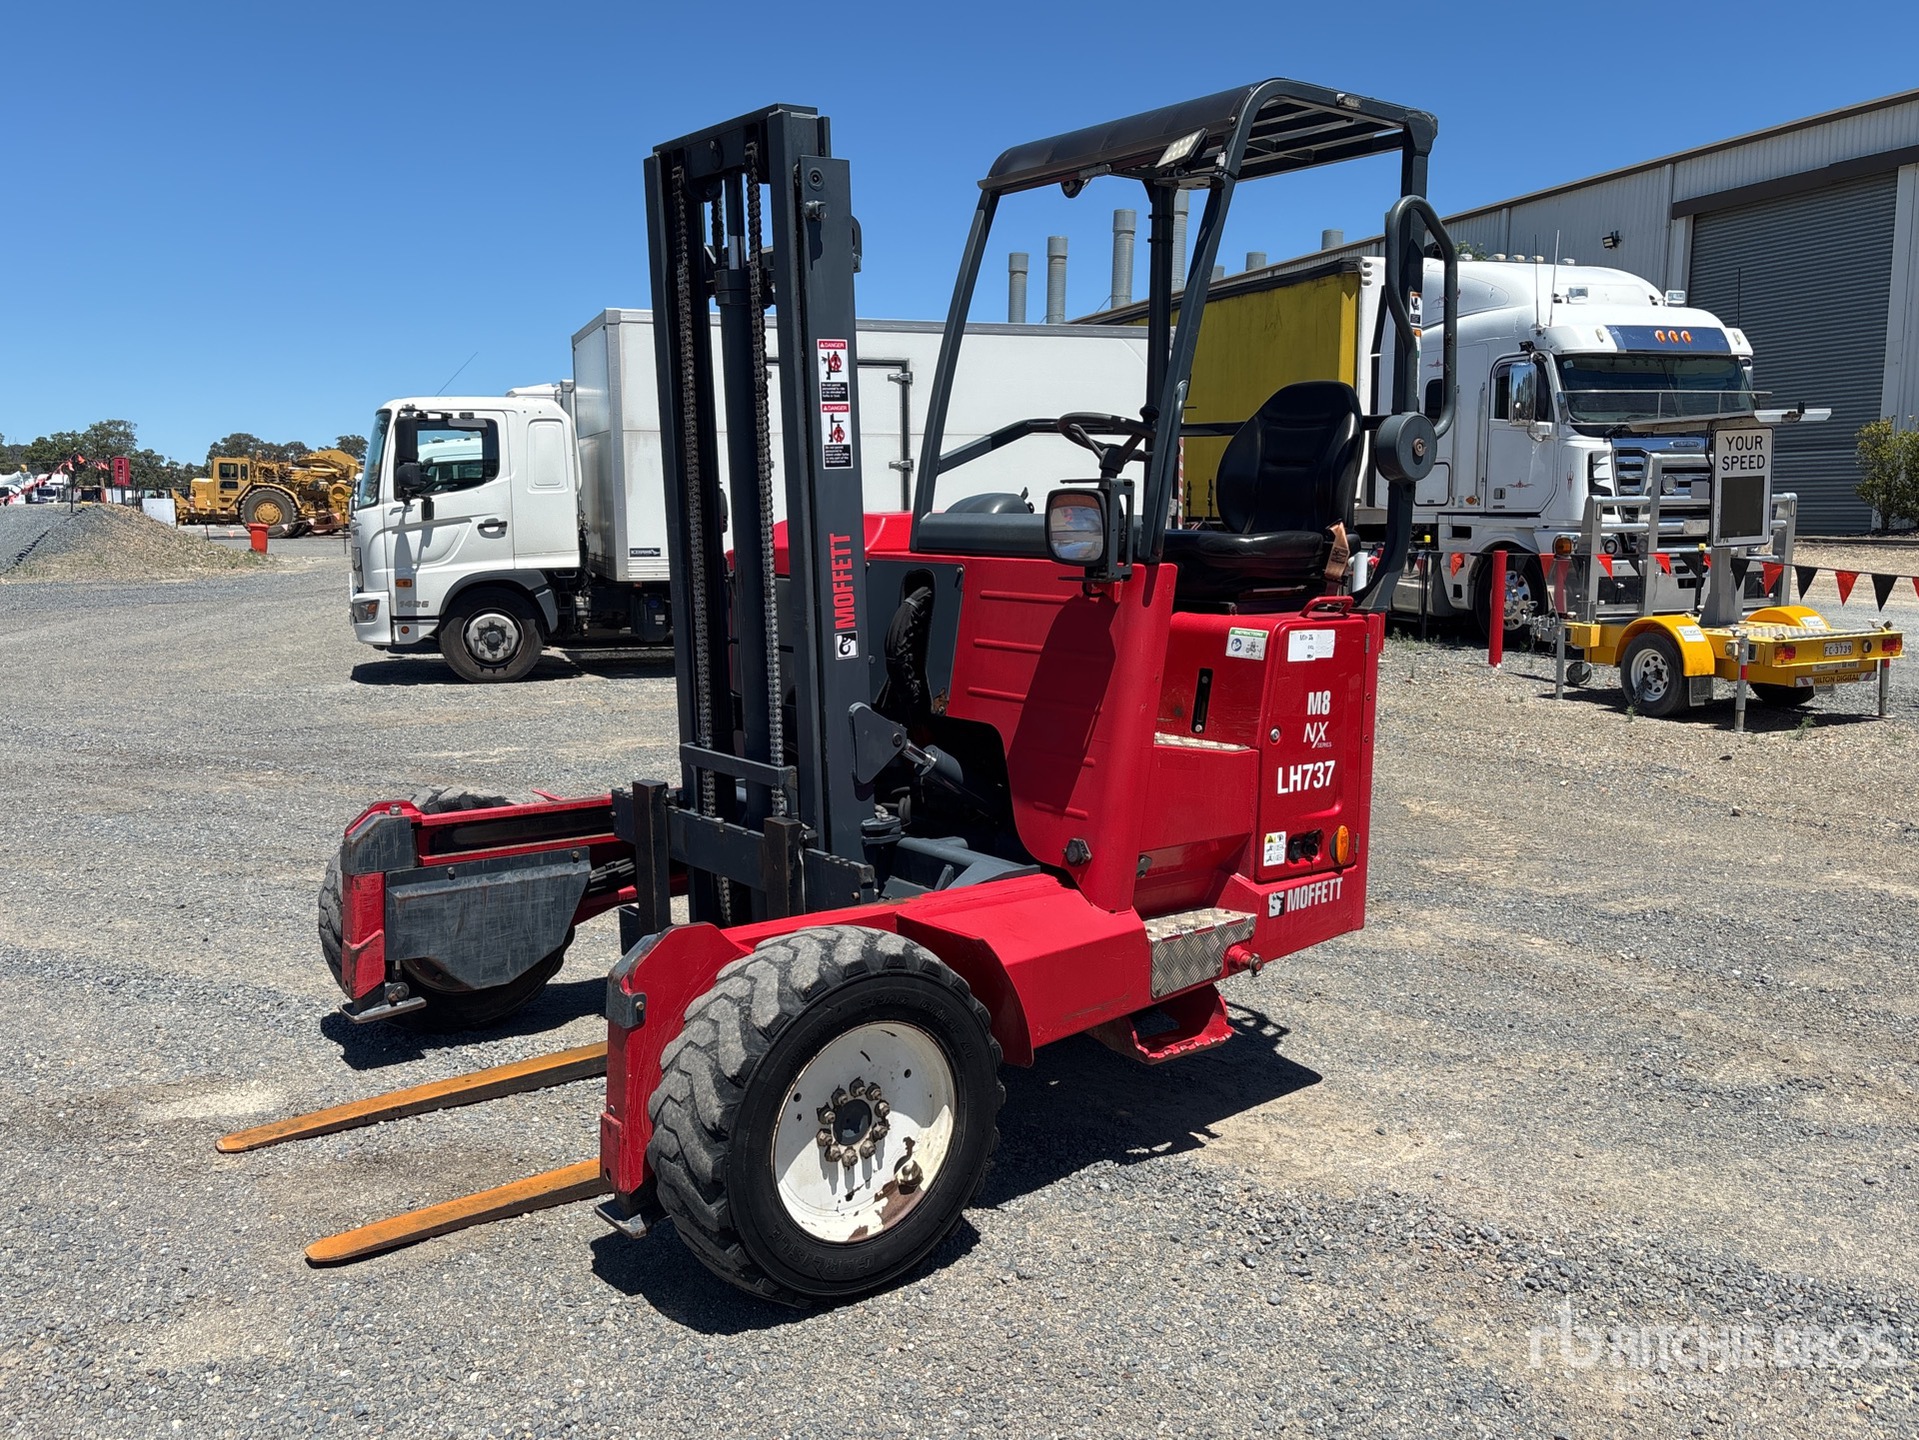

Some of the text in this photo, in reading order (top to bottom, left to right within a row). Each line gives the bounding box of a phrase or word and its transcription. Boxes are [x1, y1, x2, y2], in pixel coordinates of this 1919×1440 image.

[1725, 435, 1763, 451] YOUR
[1722, 455, 1766, 471] SPEED
[829, 533, 856, 629] MOFFETT
[1307, 690, 1331, 715] M8
[1303, 721, 1329, 749] NX
[1277, 760, 1336, 794] LH737
[1287, 877, 1343, 912] MOFFETT
